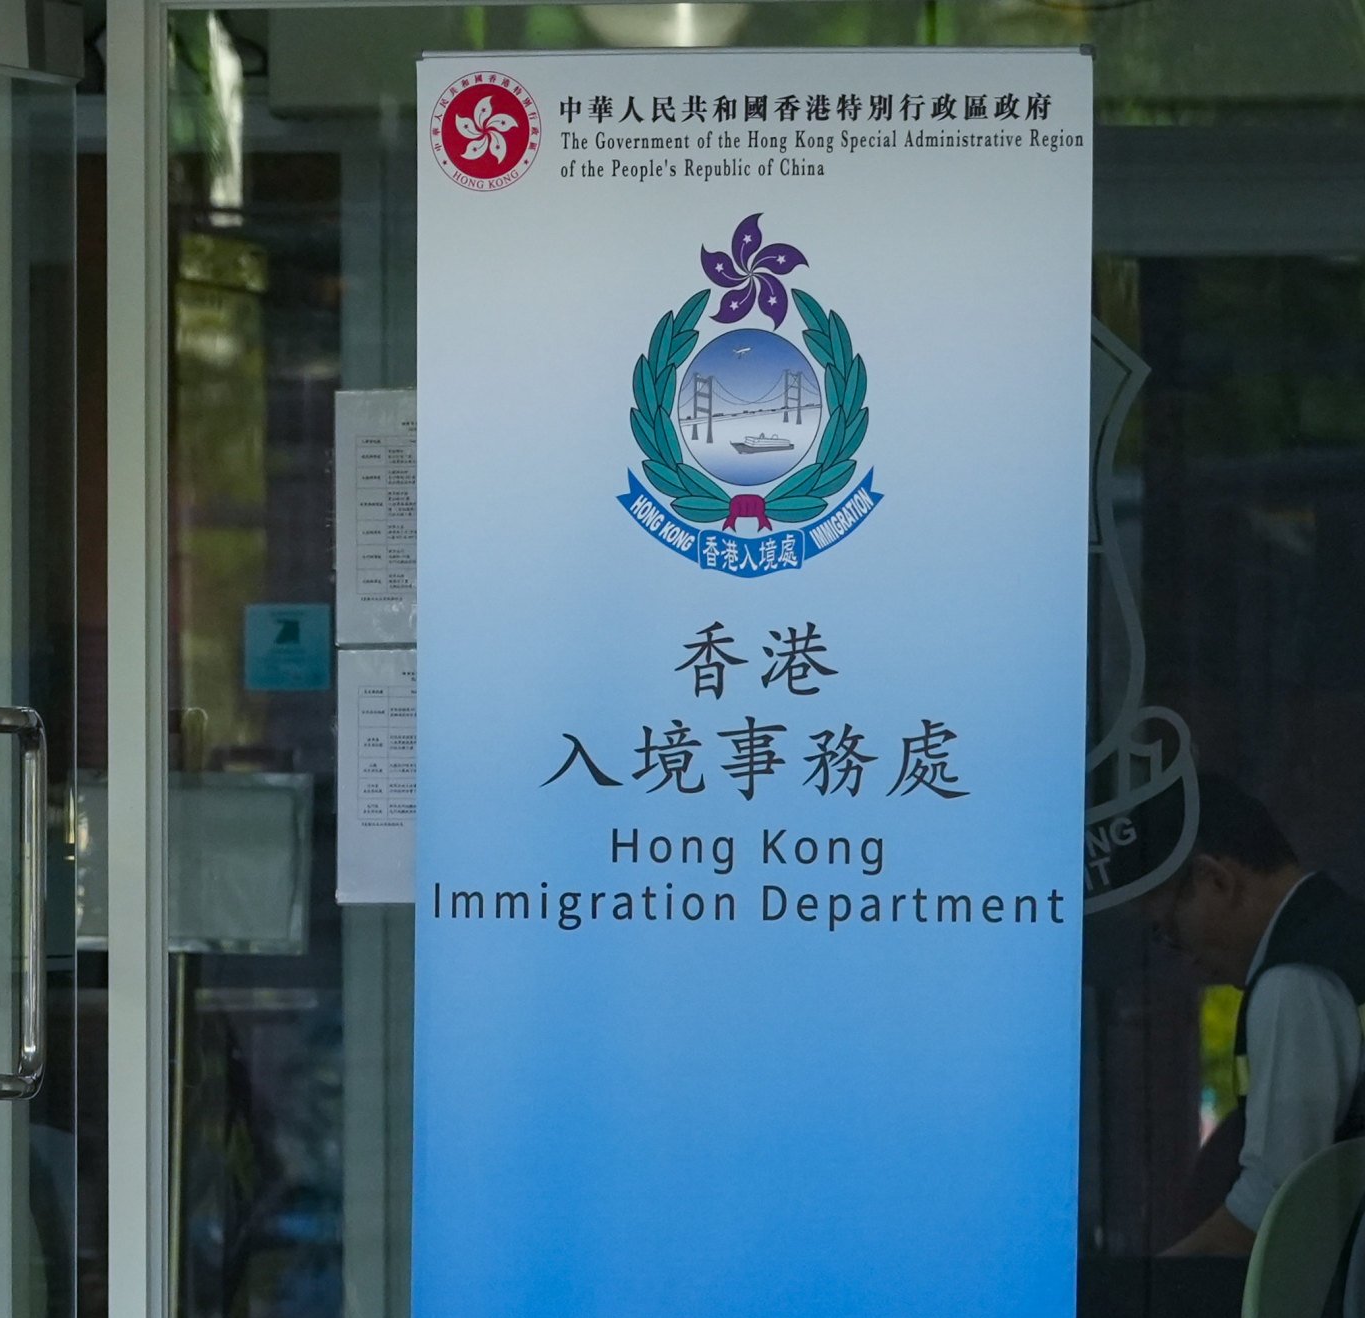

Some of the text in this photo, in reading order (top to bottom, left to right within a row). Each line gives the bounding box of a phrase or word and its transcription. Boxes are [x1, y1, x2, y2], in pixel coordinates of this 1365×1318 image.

[560, 92, 1052, 124] 中華人民共和國香港特別行政區政府
[561, 128, 1084, 152] The Government of the Hong Kong Special Administrative Region
[452, 169, 520, 190] HONG KONG
[560, 157, 825, 182] of the People's Republic of China
[630, 494, 696, 552] HONG KONG
[809, 486, 875, 550] IMMIGRATION
[702, 533, 798, 572] 香港入境處
[674, 620, 840, 701] 香港
[540, 716, 972, 801] 入境事務處
[611, 828, 884, 876] Hong Kong
[434, 882, 1065, 932] Immigration Department
